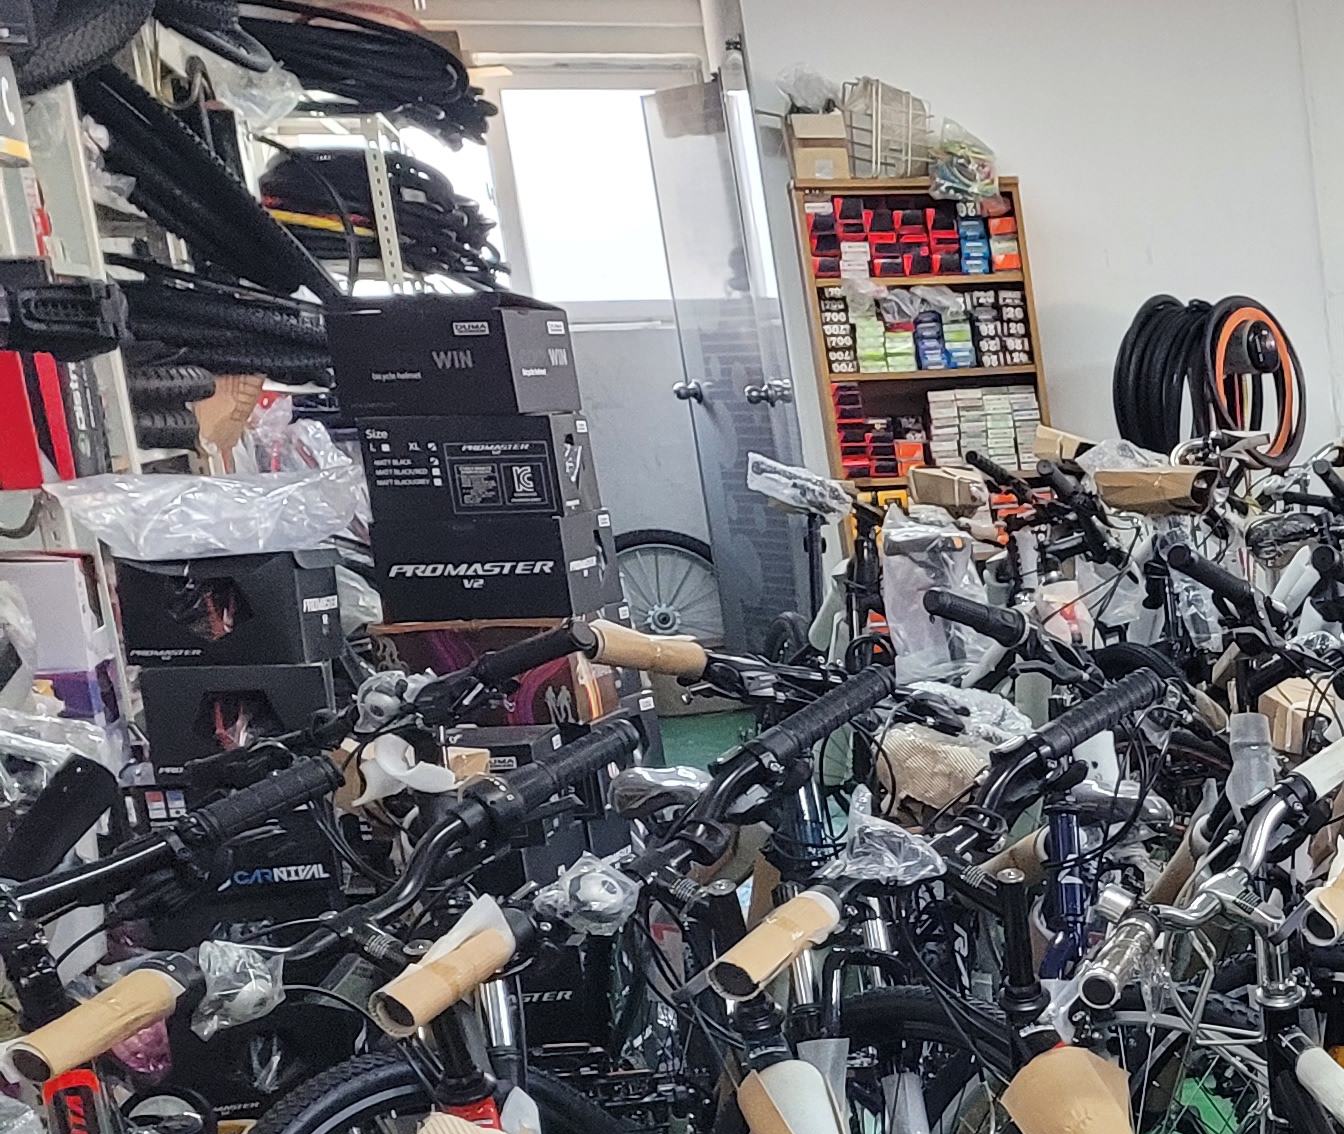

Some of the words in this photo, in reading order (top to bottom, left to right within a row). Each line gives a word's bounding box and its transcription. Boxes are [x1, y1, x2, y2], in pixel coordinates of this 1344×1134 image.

[432, 350, 473, 369] WIN
[548, 348, 568, 366] WIN
[365, 429, 389, 440] Size
[408, 442, 421, 451] XL
[389, 560, 554, 578] PROMASTER
[462, 578, 484, 589] V2
[129, 649, 202, 657] PROMASTER
[233, 862, 330, 885] CARNIVAL
